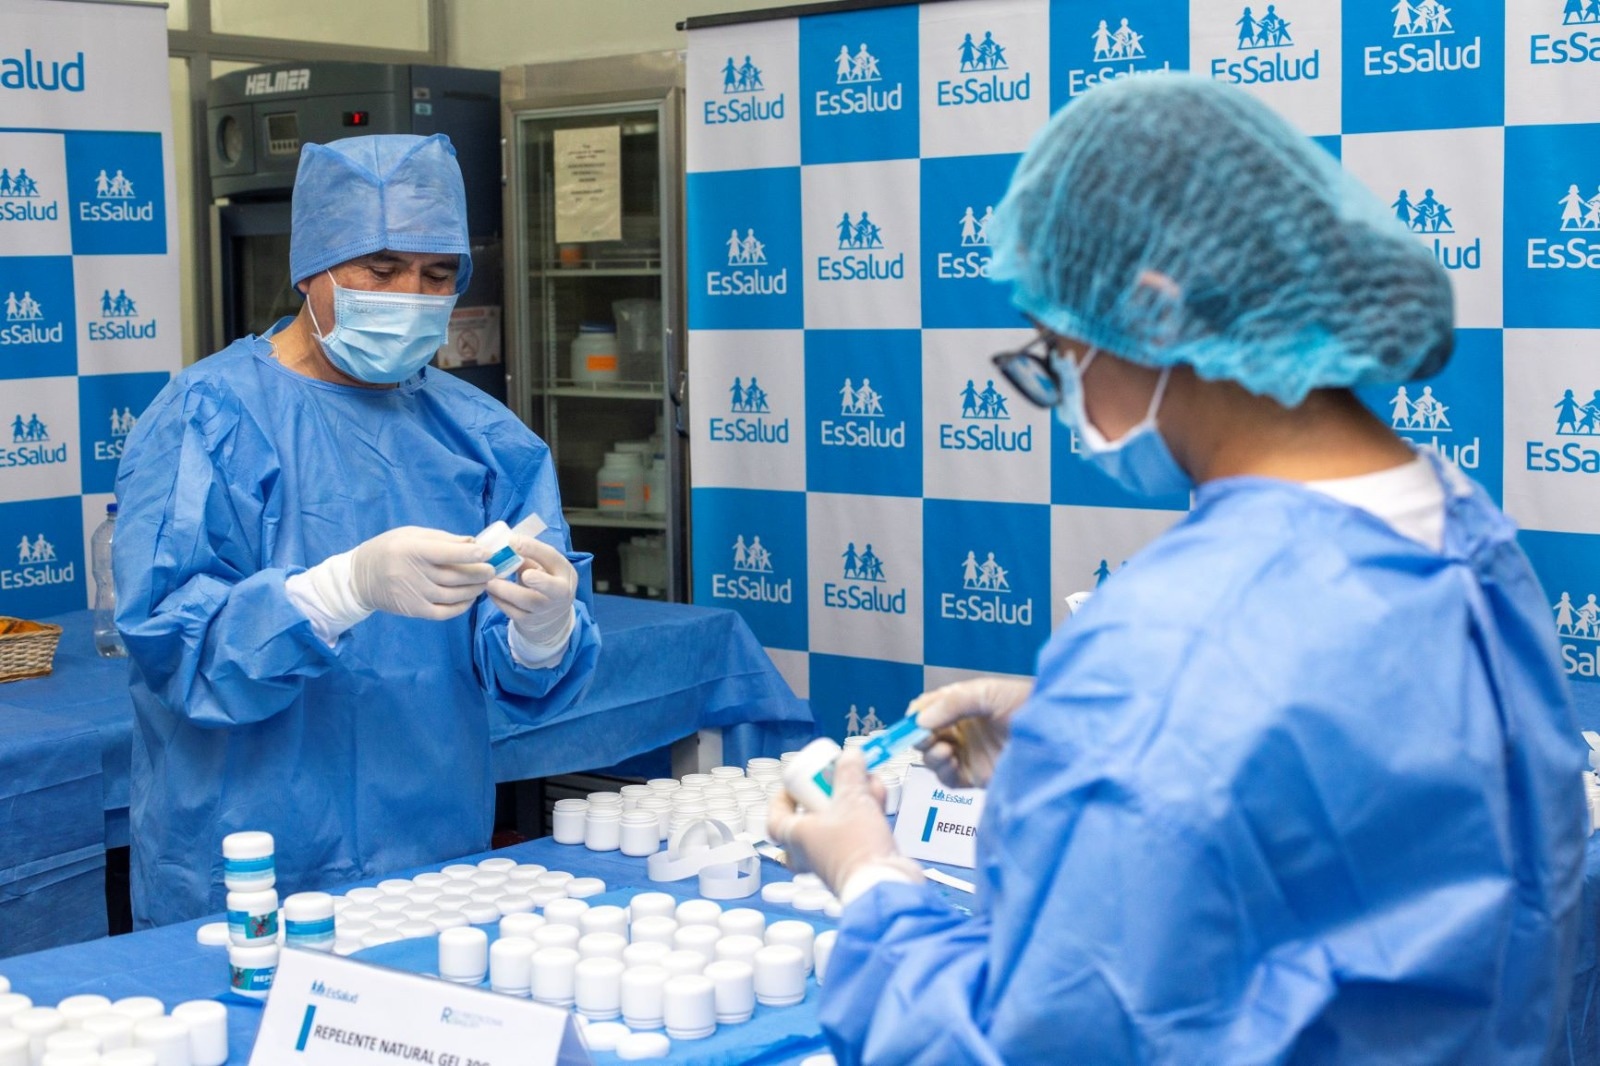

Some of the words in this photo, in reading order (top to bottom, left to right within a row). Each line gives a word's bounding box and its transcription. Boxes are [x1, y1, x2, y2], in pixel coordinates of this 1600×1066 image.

[1364, 36, 1481, 76] EsSalud
[1531, 32, 1600, 64] EsSa
[1, 49, 85, 92] alud
[245, 69, 311, 96] HELMER
[816, 82, 902, 116] EsSalud
[938, 72, 1030, 107] EsSalud
[704, 93, 784, 125] EsSalud
[0, 200, 58, 221] Salud
[80, 201, 153, 221] EsSalud
[818, 253, 904, 281] EsSalud
[938, 252, 993, 278] EsSa
[1528, 237, 1600, 269] EsSa
[707, 268, 787, 296] EsSalud
[1, 322, 63, 345] sSalud
[88, 319, 156, 341] EsSalud
[710, 418, 789, 444] EsSalud
[821, 420, 905, 449] EsSalud
[940, 423, 1032, 452] EsSalud
[1526, 441, 1600, 473] EsSa
[1, 562, 74, 589] EsSalud
[712, 574, 792, 605] EsSalud
[824, 582, 906, 615] EsSalud
[941, 592, 1033, 627] EsSalud
[945, 793, 974, 806] EsSalud
[314, 1024, 378, 1051] REPELENTE
[379, 1039, 434, 1065] NATURAL
